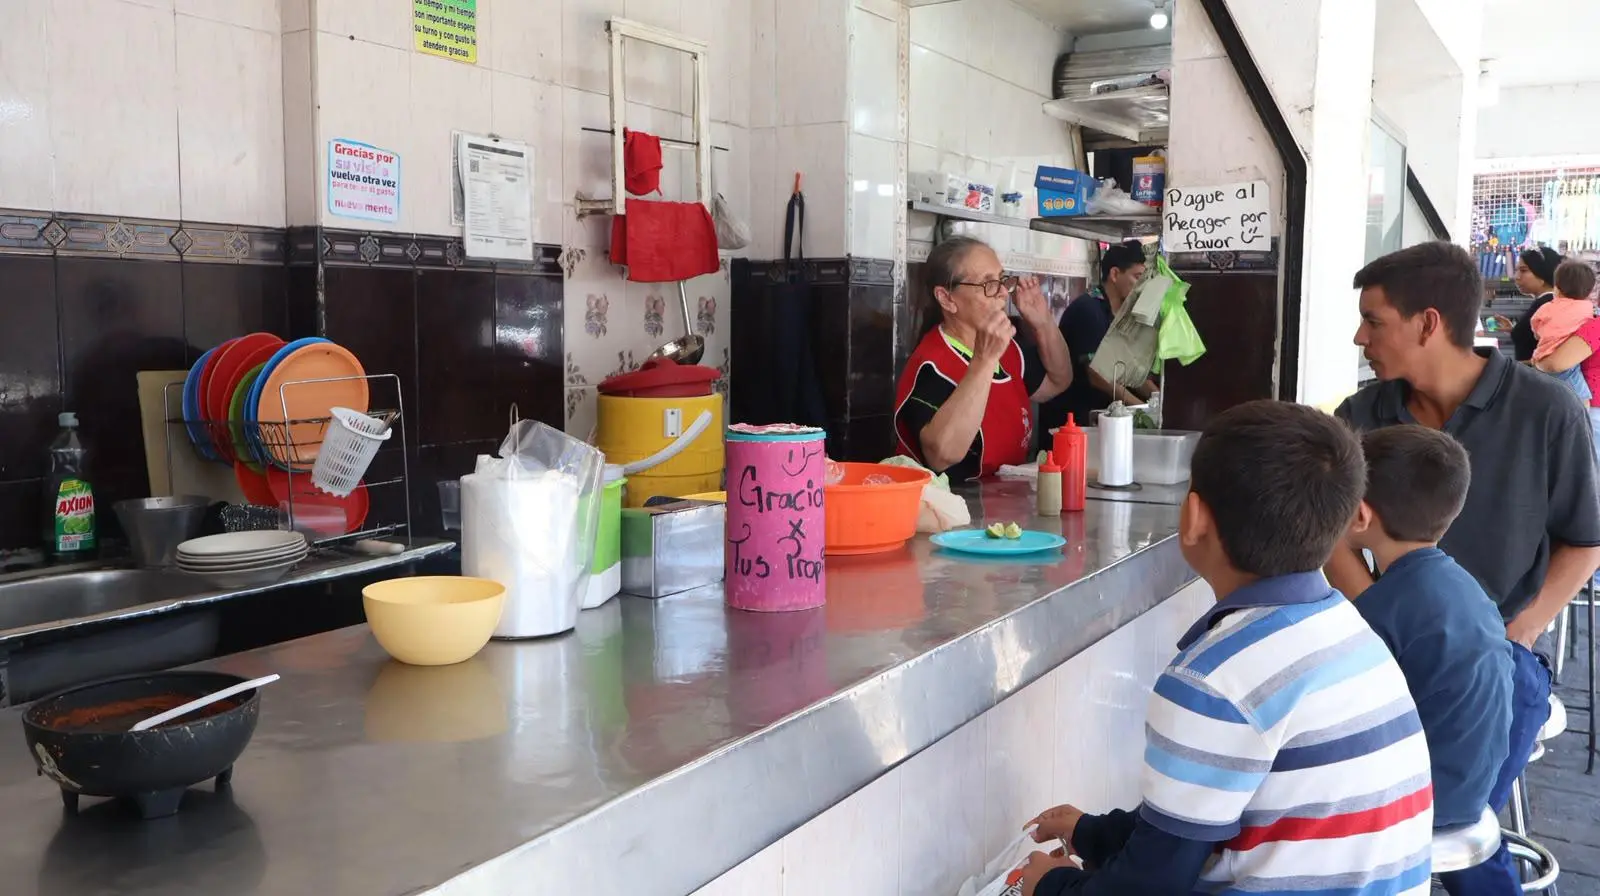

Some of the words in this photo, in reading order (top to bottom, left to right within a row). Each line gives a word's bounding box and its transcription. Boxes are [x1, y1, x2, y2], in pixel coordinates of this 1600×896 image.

[424, 0, 443, 10] tiempo
[457, 7, 475, 19] tiempo
[426, 12, 456, 27] importante
[458, 21, 476, 32] espere
[422, 25, 438, 36] turno
[439, 31, 442, 39] y
[444, 32, 454, 40] con
[455, 34, 470, 44] gusto
[471, 36, 476, 45] le
[423, 40, 448, 52] atendere
[449, 46, 469, 57] gracias
[335, 144, 374, 160] Gracias
[376, 154, 394, 163] por
[336, 158, 350, 169] su
[352, 160, 389, 177] visia
[331, 170, 360, 182] vuelva
[362, 175, 380, 185] otra
[381, 180, 396, 188] vez
[332, 180, 348, 189] para
[350, 182, 368, 191] teer
[335, 199, 393, 215] nuevmente
[1167, 188, 1224, 211] Pague
[1236, 184, 1255, 199] al
[1165, 212, 1231, 234] Recoger
[1241, 211, 1267, 226] por
[1184, 231, 1234, 250] favor
[57, 496, 92, 515] AXION
[729, 523, 770, 578] Tus
